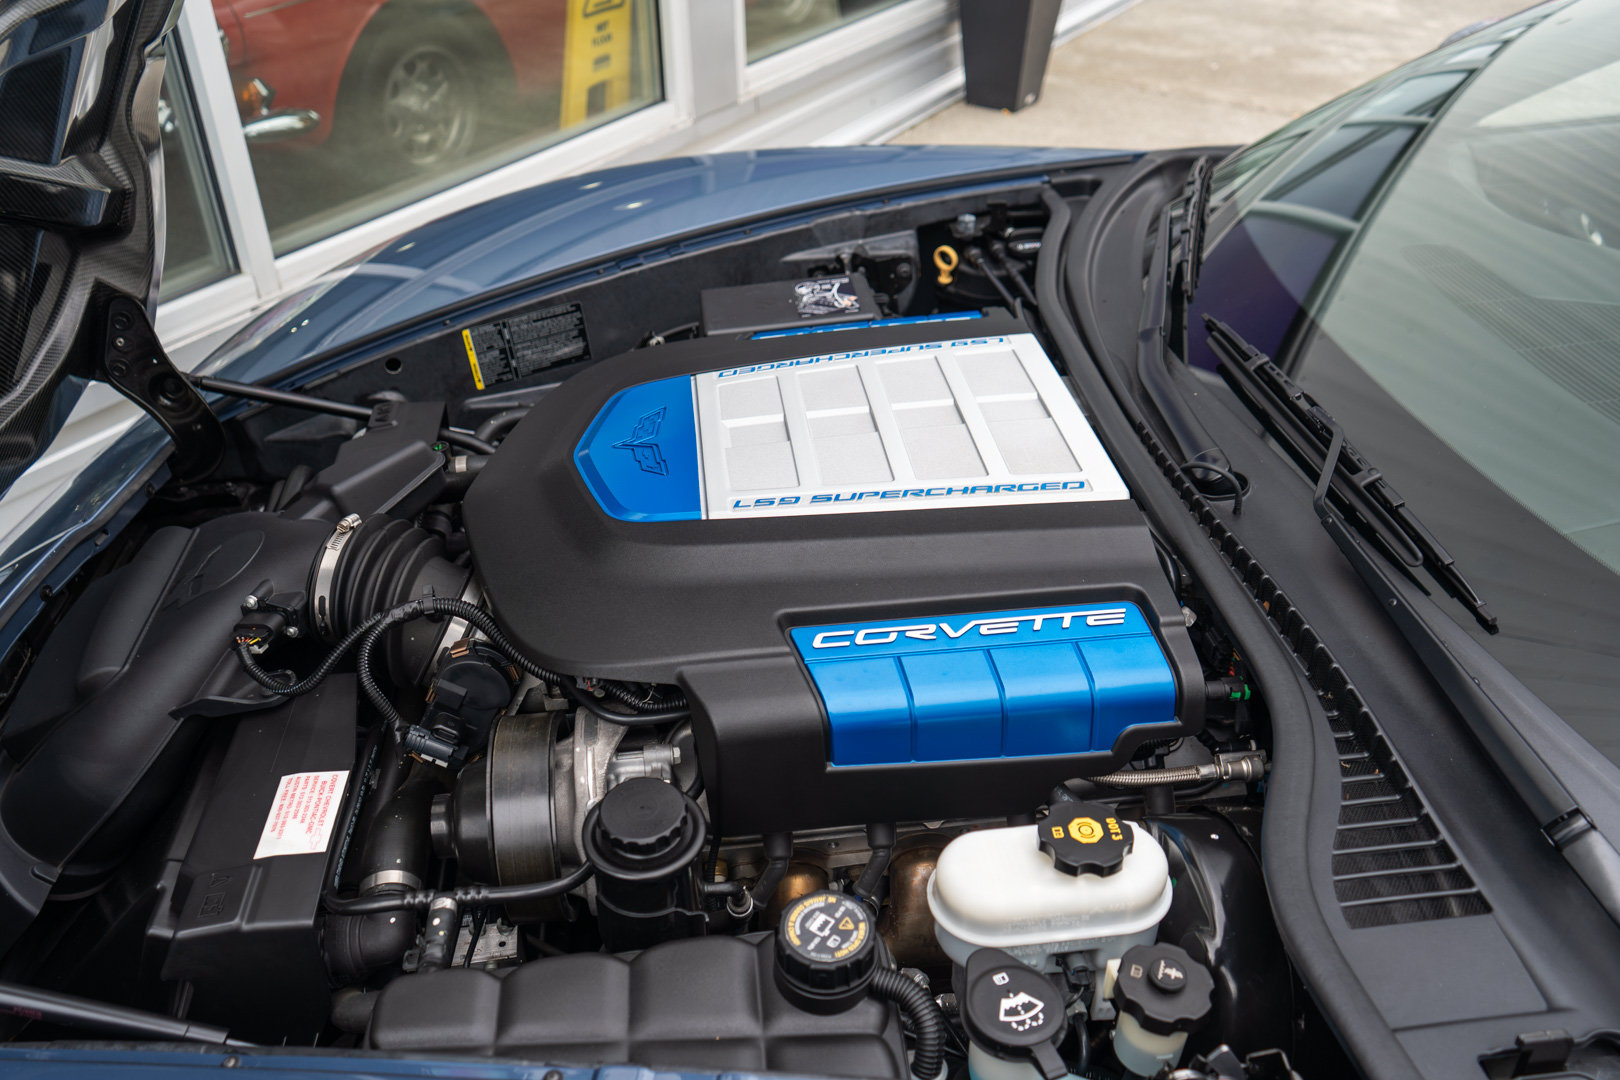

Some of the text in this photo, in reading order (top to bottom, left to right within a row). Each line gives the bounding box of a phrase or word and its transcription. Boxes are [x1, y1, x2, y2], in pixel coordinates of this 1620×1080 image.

[718, 336, 1005, 378] LS9 SUPERCHARGED
[732, 480, 1085, 509] LS9 SUPERCHARGED
[812, 608, 1127, 649] CORVETTE
[318, 774, 338, 826] COVERT CHEVROLET
[1106, 817, 1122, 834] DOT
